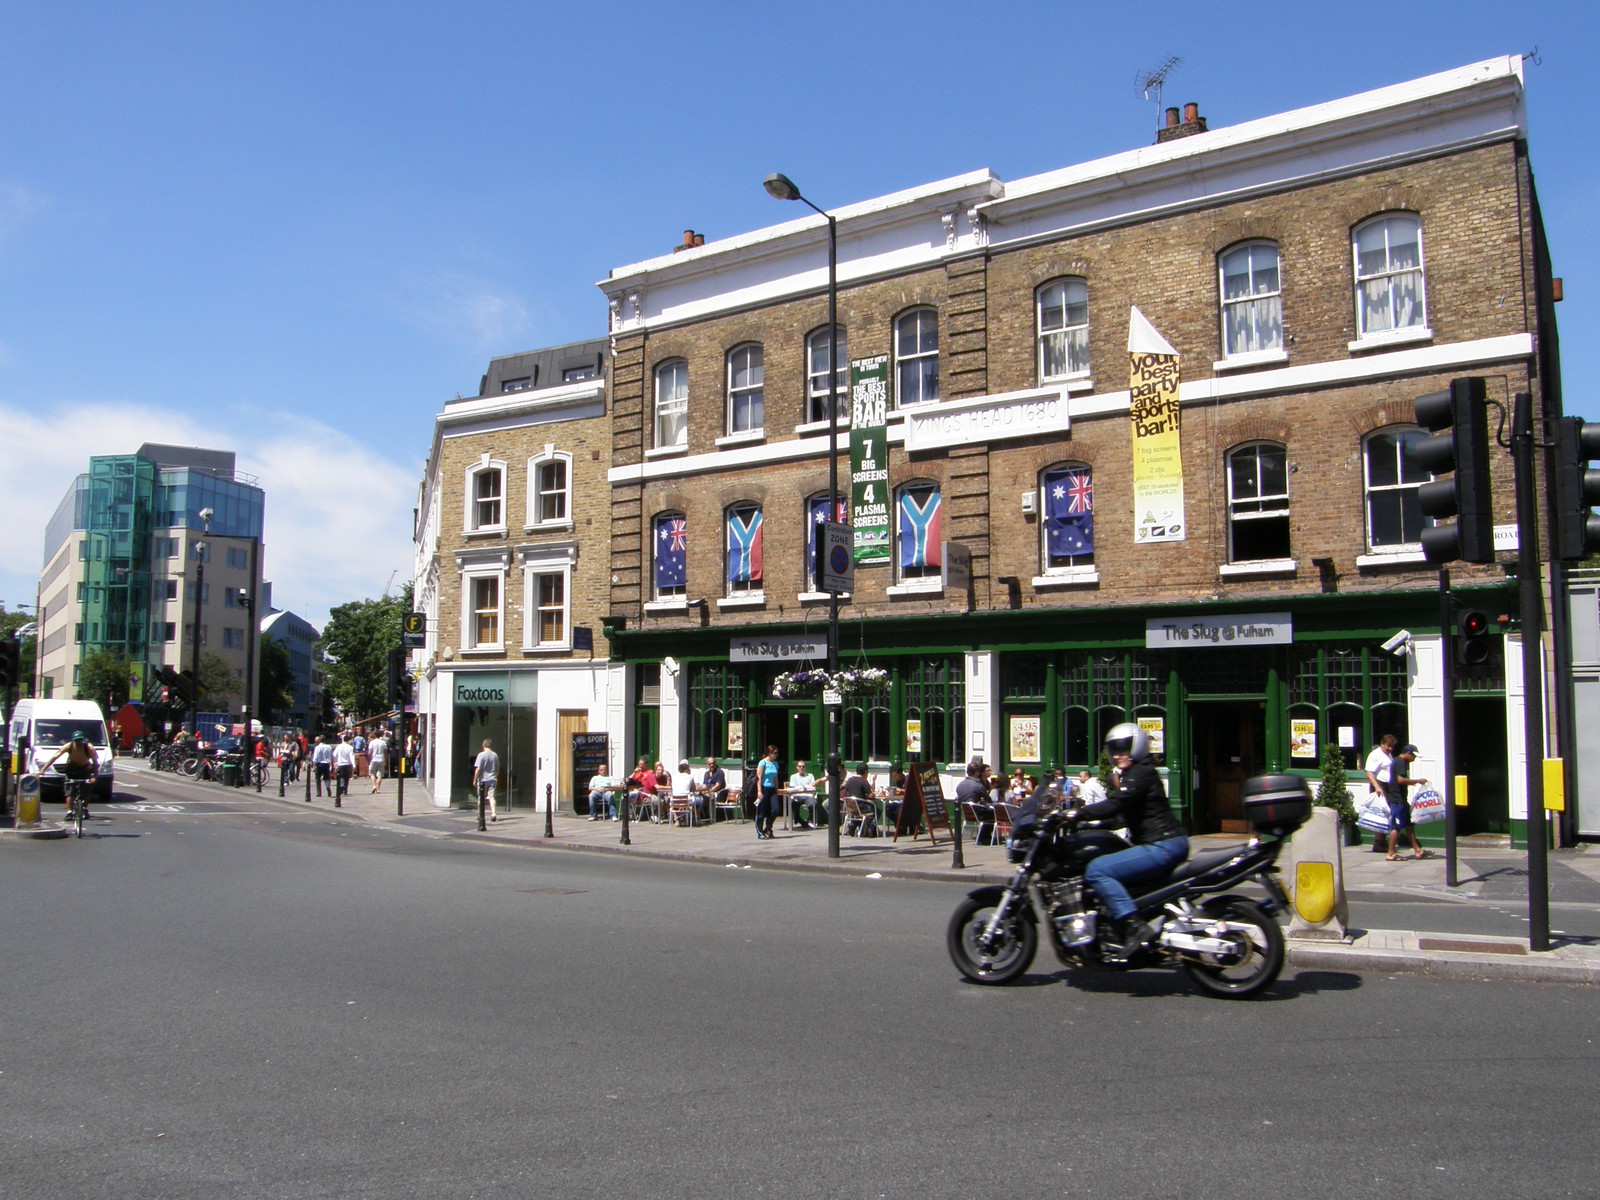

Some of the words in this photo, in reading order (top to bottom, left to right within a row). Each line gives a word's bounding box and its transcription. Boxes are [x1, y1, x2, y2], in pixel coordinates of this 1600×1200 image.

[852, 360, 860, 368] THE
[862, 358, 874, 366] BEST
[1130, 354, 1174, 375] your
[1141, 360, 1179, 381] best
[853, 385, 866, 395] THE
[868, 381, 886, 392] BEST
[1130, 376, 1179, 403] party
[853, 390, 886, 405] SPORTS
[1135, 391, 1161, 409] and
[853, 401, 886, 424] BAR
[914, 414, 962, 436] KINGS
[970, 407, 1013, 430] HEAD
[1020, 400, 1058, 422] 1680
[1131, 399, 1179, 423] sports
[858, 421, 867, 429] THE
[868, 420, 886, 428] WORLD
[1135, 413, 1179, 438] bar!!
[863, 440, 872, 459] 7
[1153, 445, 1177, 453] screens
[861, 459, 875, 471] BIG
[1147, 456, 1173, 464] plasmas
[853, 469, 887, 483] SCREENS
[1155, 466, 1165, 474] djs
[863, 484, 875, 503] 4
[855, 504, 886, 517] PLASMA
[853, 515, 888, 528] SCREENS
[831, 535, 849, 545] ZONE
[410, 617, 418, 630] F
[1162, 624, 1189, 641] The
[1192, 623, 1220, 643] Slug
[1222, 625, 1235, 641] @
[1237, 625, 1274, 638] Fulham
[740, 642, 759, 656] The
[760, 641, 779, 658] Slug
[790, 643, 815, 654] Fulham
[458, 685, 504, 701] Foxtons
